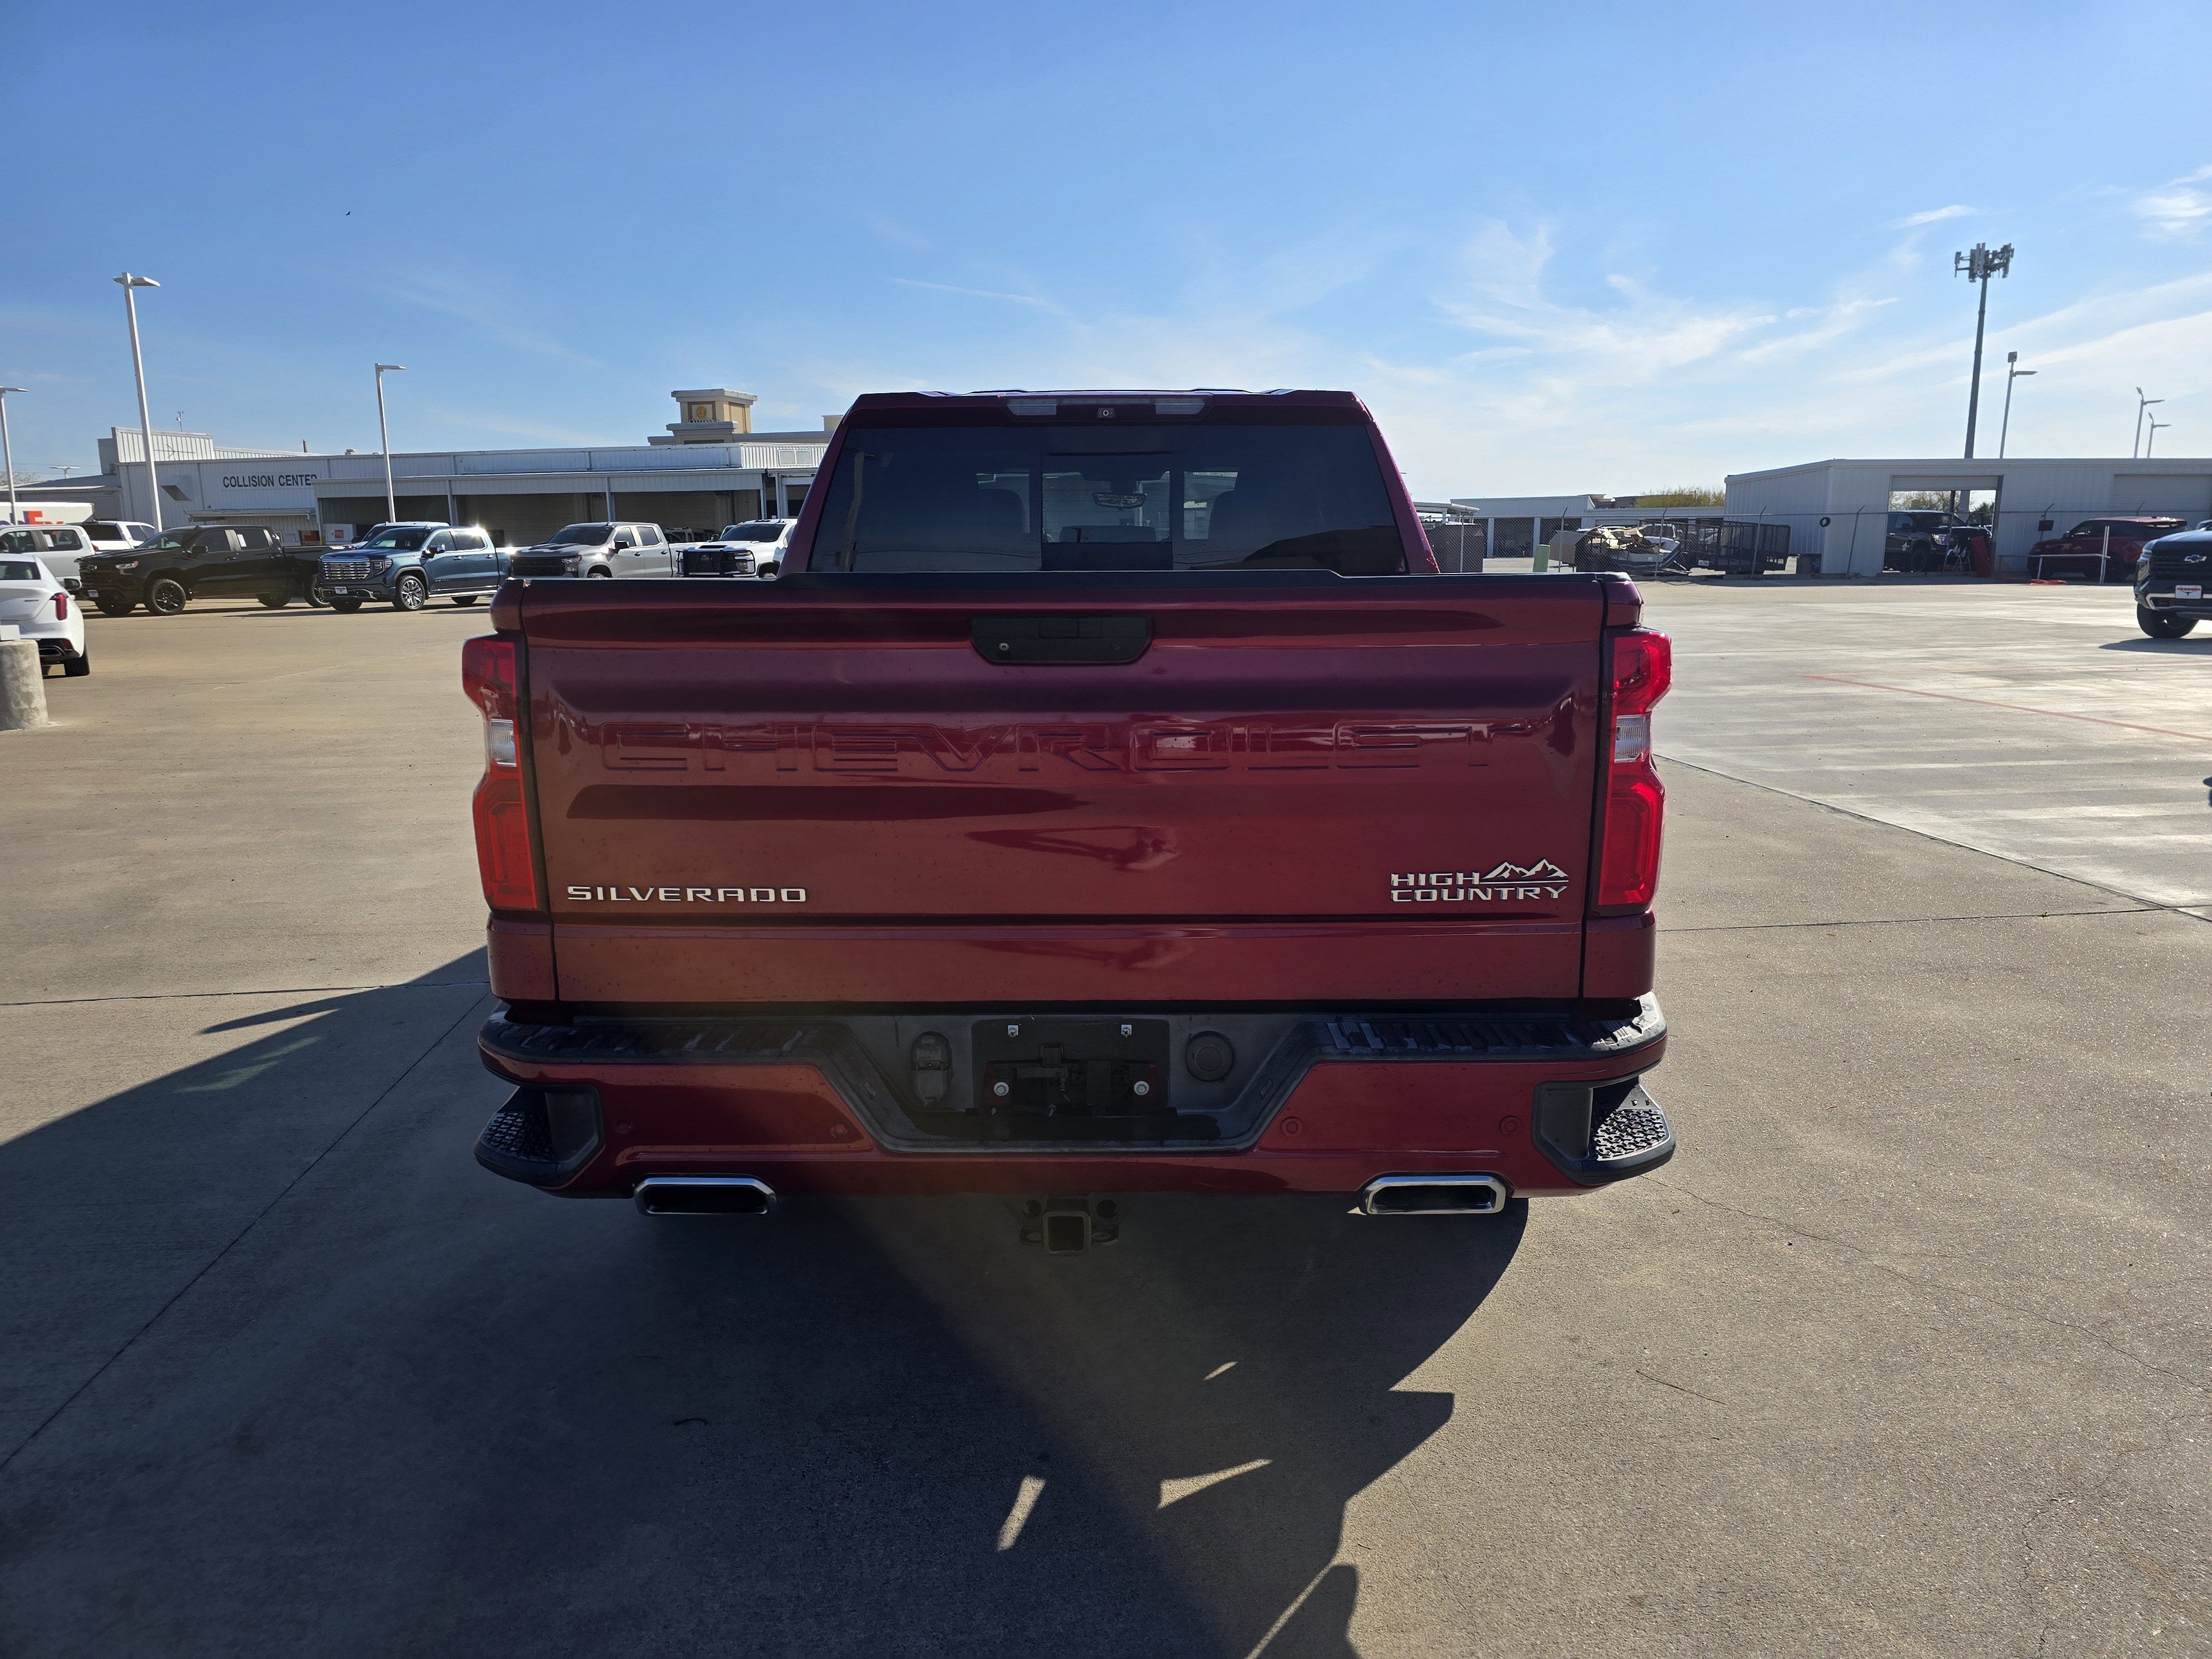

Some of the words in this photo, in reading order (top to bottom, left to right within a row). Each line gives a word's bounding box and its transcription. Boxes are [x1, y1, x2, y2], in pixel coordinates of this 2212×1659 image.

[223, 475, 274, 488] COLLISION
[601, 718, 1529, 772] CHEVROLET
[1391, 872, 1480, 886] HIGH
[567, 886, 806, 902] SILVERADO
[1391, 885, 1568, 902] COUNTRY
